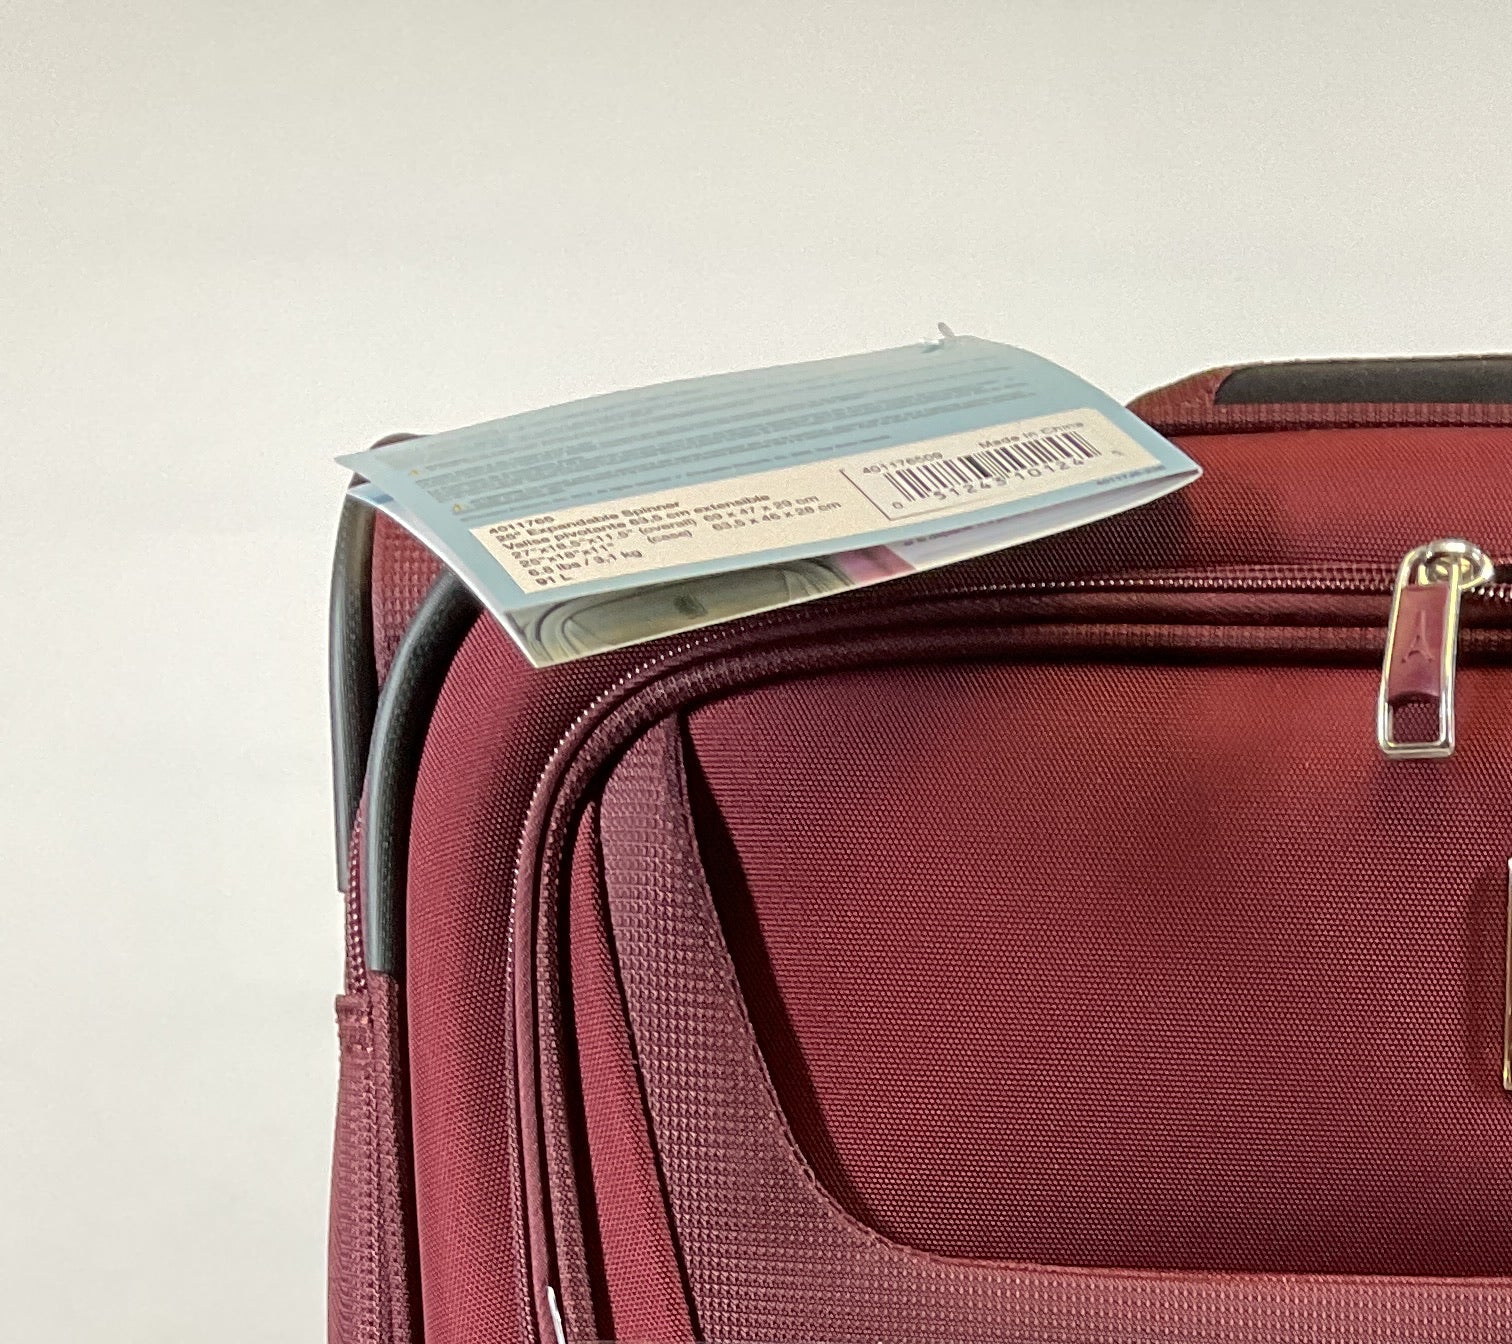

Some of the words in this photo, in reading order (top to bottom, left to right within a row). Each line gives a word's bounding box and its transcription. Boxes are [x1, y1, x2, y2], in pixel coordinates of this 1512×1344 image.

[979, 436, 1020, 448] Made
[1039, 422, 1084, 434] China
[694, 495, 770, 514] extensible
[527, 513, 619, 536] Expandable
[622, 502, 680, 517] Spinner
